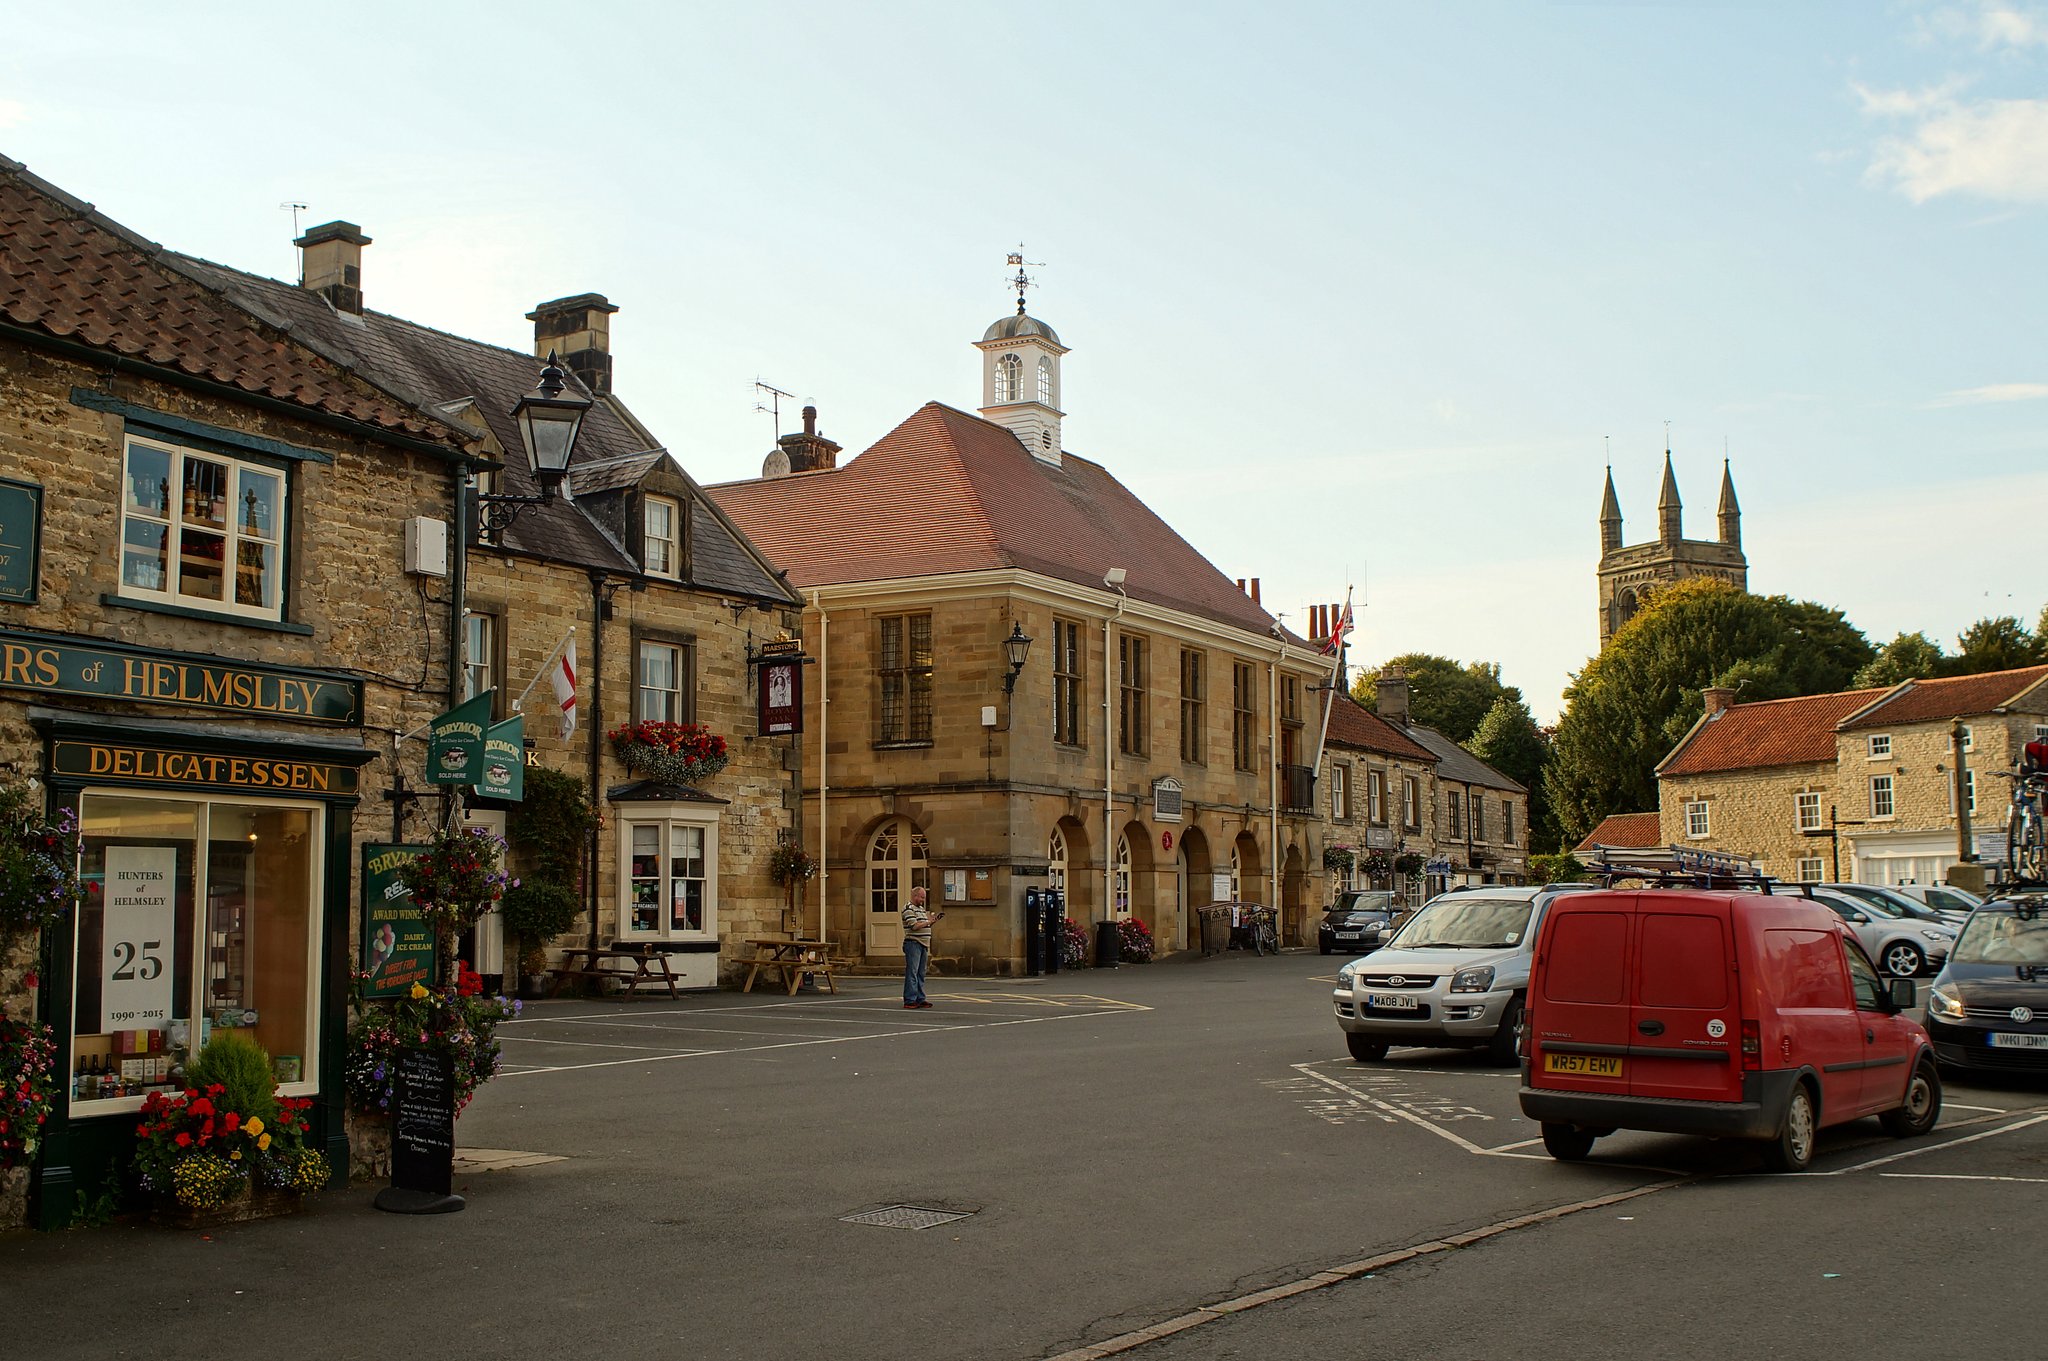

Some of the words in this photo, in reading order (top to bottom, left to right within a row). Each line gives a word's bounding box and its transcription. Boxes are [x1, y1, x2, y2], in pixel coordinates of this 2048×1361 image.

[764, 643, 797, 652] MARSTON'S
[0, 644, 60, 686] RS
[82, 661, 104, 683] of
[122, 659, 322, 715] HELMSLEY
[765, 707, 797, 715] ROYAL
[769, 715, 791, 723] OAK
[436, 722, 482, 740] BRYMOR
[485, 740, 519, 761] RYMOR
[89, 747, 330, 790] DELICATESSEN
[368, 851, 415, 875] BRYM
[118, 872, 163, 880] HUNTERS
[136, 885, 145, 893] of
[114, 897, 166, 906] HELMSLEY
[1028, 895, 1033, 904] P
[1047, 895, 1052, 903] P
[373, 910, 398, 920] AWARD
[404, 933, 425, 941] DAIRY
[409, 943, 432, 951] CREAM
[112, 939, 163, 981] 25
[404, 958, 417, 971] FROM
[376, 979, 386, 990] THE
[1374, 996, 1397, 1007] MA08
[1400, 997, 1416, 1008] JVL
[111, 1011, 135, 1021] 1990
[142, 1009, 164, 1018] 2015
[1710, 1025, 1722, 1033] 70
[1552, 1056, 1586, 1070] WR57
[1589, 1059, 1617, 1073] EHV
